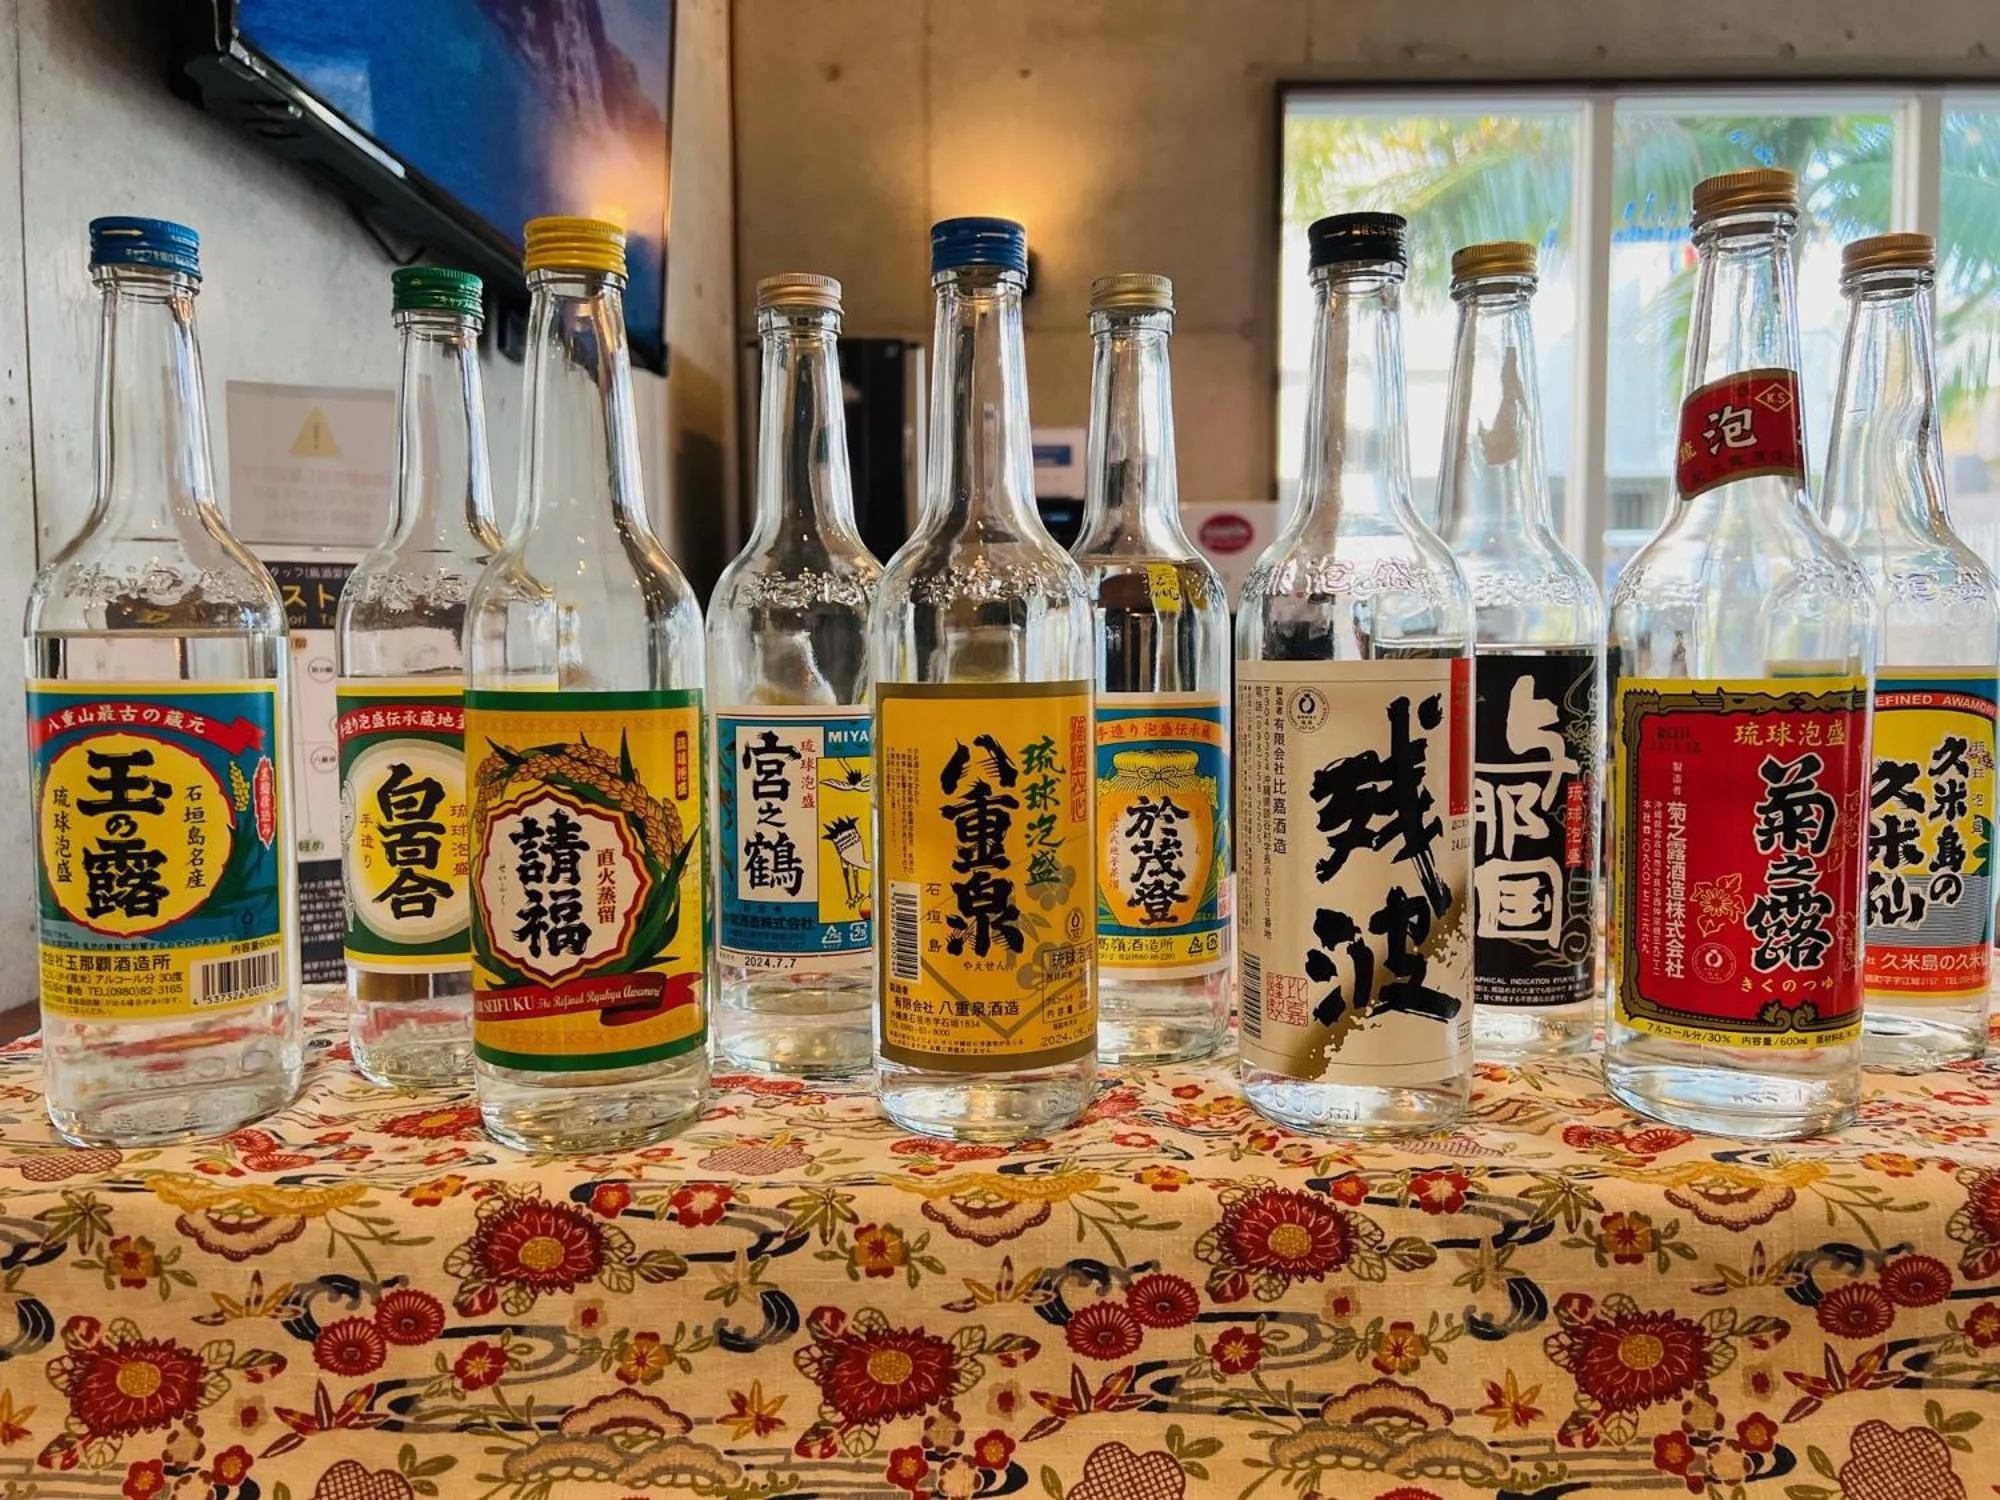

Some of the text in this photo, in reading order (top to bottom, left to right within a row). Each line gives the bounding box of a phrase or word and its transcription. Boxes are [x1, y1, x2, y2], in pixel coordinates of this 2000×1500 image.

[49, 703, 207, 735] 八重山最古の蔵元
[827, 730, 869, 743] MIYA
[1733, 720, 1846, 748] 琉球泡盛
[1874, 693, 1994, 718] EFINED AWAMORI
[800, 738, 817, 809] 琉球泡盛
[1018, 734, 1067, 888] 琉球泡盛
[52, 784, 74, 884] 琉球泡盛
[76, 749, 174, 919] 玉の露
[183, 784, 208, 891] 石垣島名産
[359, 811, 375, 870] 手造り
[371, 761, 455, 921] 白百合
[449, 801, 469, 878] 琉球泡盛
[937, 733, 1025, 958] 八重泉
[1568, 783, 1583, 867] 琉球泡盛
[1927, 735, 1970, 906] 久米島の
[508, 808, 593, 961] 請福
[595, 847, 618, 925] 直火蒸留
[1124, 795, 1192, 926] 於茂登
[1664, 800, 1688, 980] 菊之露酒造株式会社
[1745, 752, 1839, 974] 菊之露
[923, 881, 944, 954] 石垣島
[66, 953, 172, 972] 玉那覇酒造所
[744, 955, 798, 969] 2024.7.7
[1739, 977, 1835, 994] きくのつゆ
[938, 999, 1020, 1017] 八重泉酒造
[1646, 1021, 1732, 1045] アルコール分/30%
